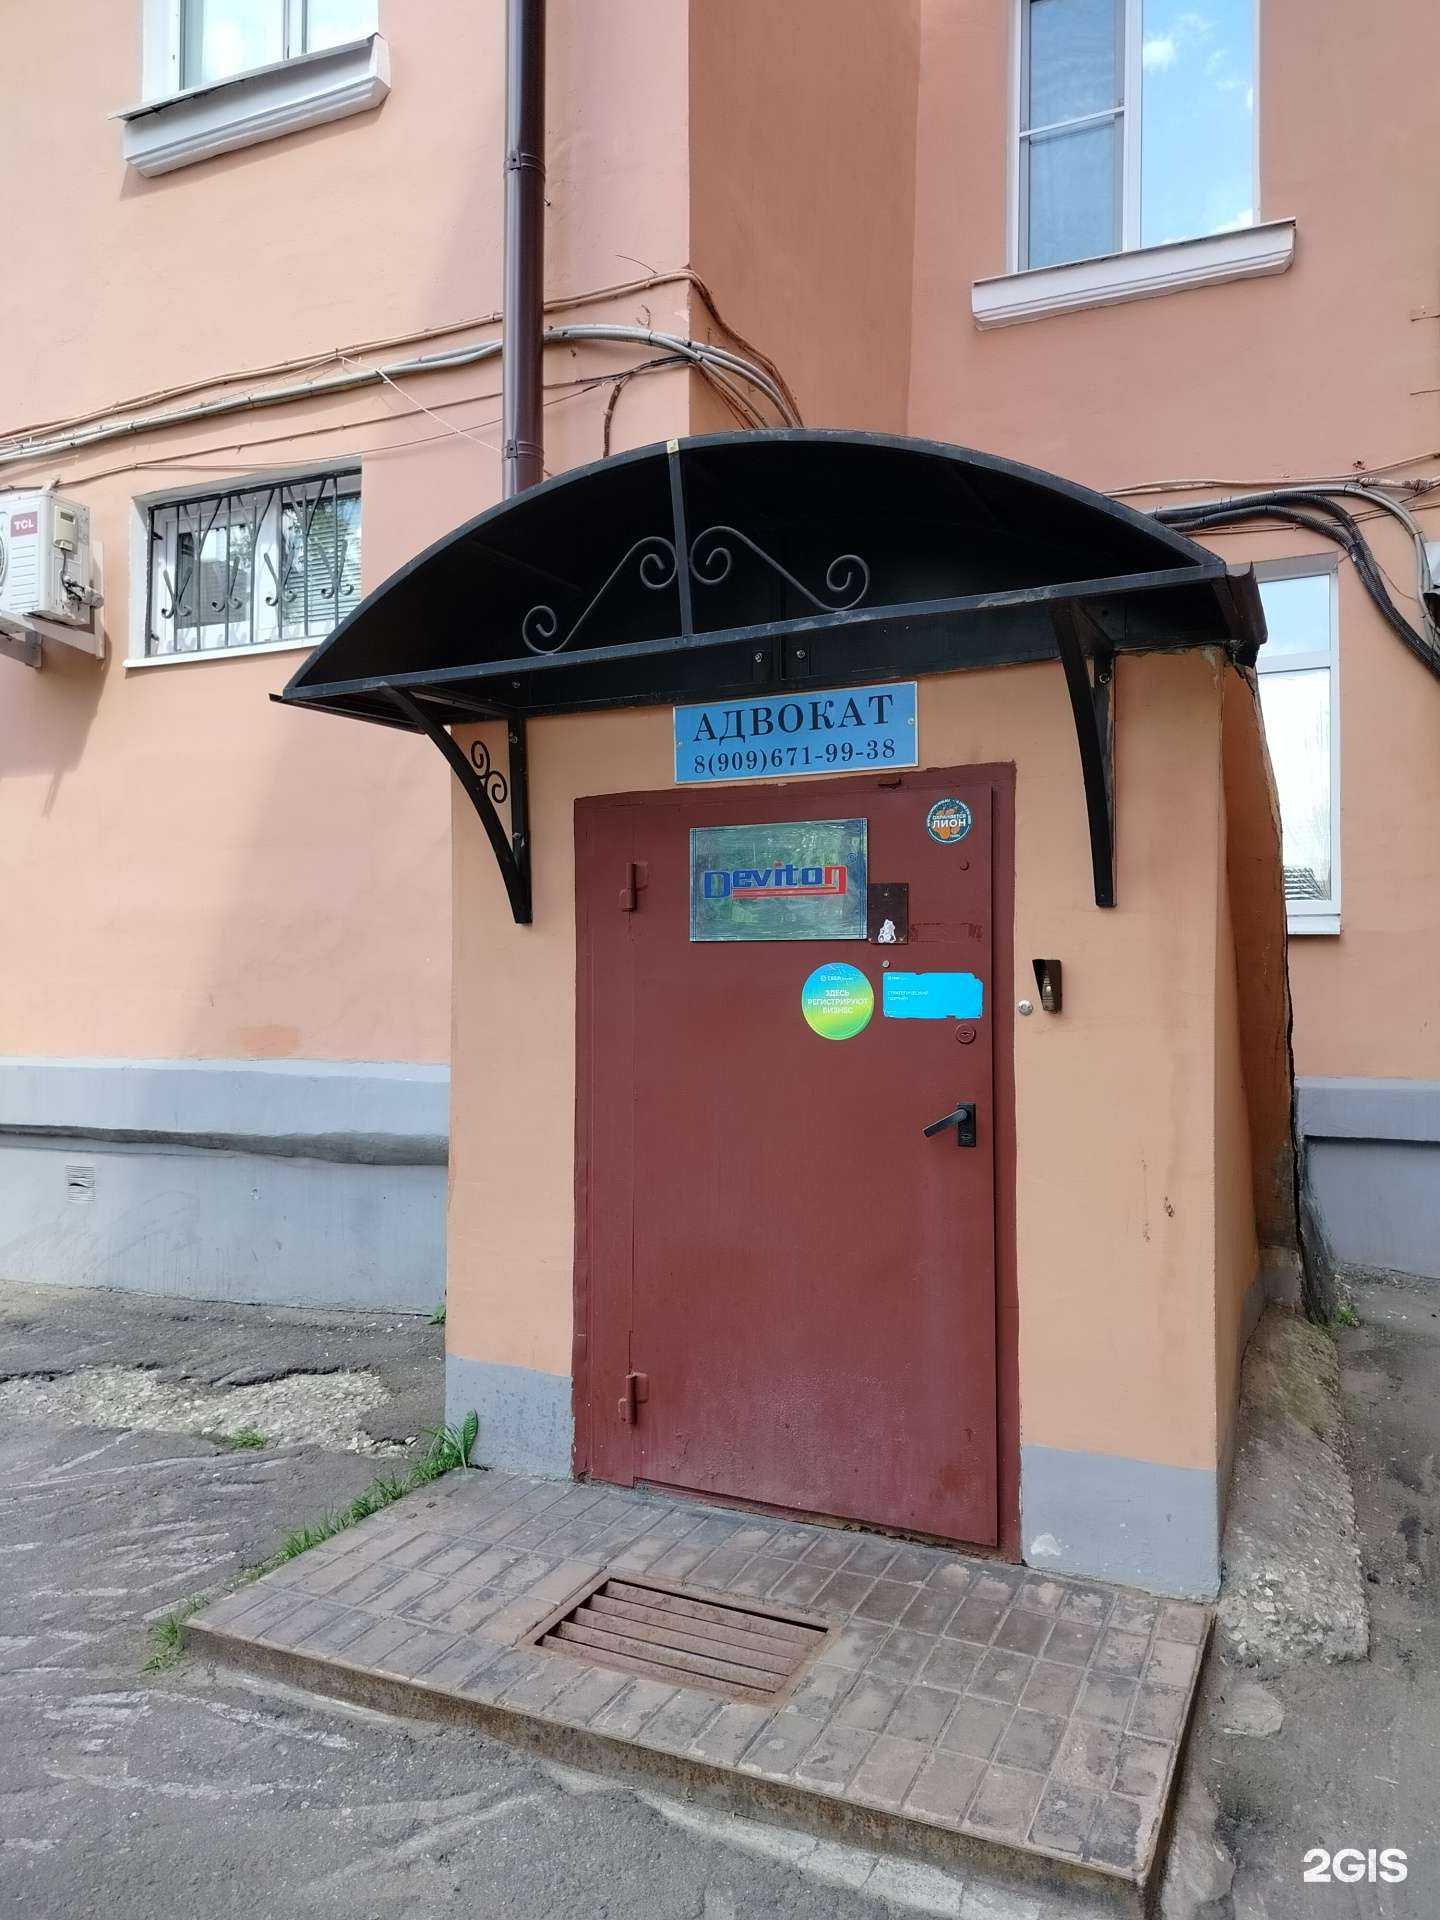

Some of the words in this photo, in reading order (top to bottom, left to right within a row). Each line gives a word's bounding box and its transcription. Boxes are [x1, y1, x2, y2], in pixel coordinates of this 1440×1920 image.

[14, 520, 35, 530] TCL
[692, 694, 893, 746] АДВОКАТ
[694, 739, 896, 776] 8(909)671-99-38
[932, 818, 966, 829] ЛИОН
[703, 859, 847, 900] Deviton
[825, 989, 850, 997] ЗДЕСЬ
[807, 998, 868, 1006] РЕГИСТРИРУЮТ
[822, 1006, 854, 1014] БИЗНЕС
